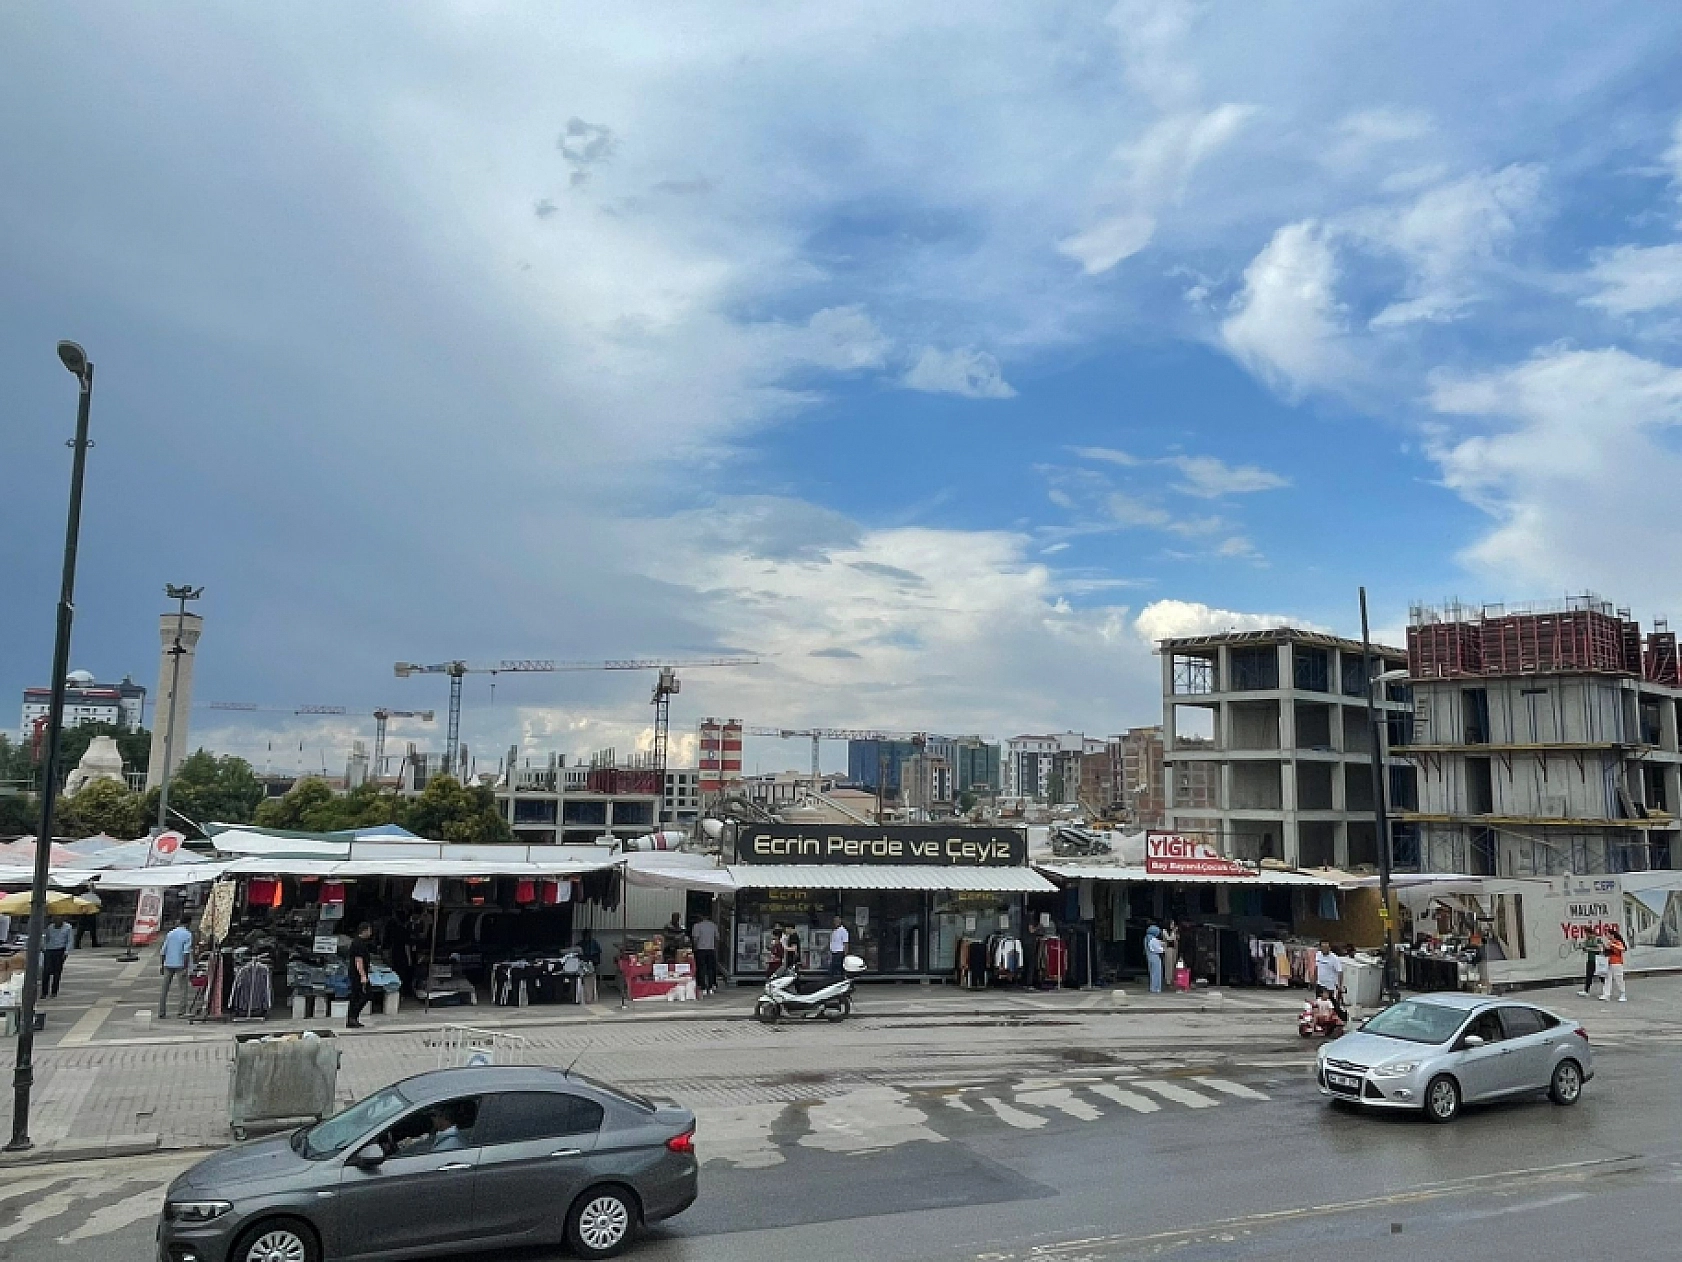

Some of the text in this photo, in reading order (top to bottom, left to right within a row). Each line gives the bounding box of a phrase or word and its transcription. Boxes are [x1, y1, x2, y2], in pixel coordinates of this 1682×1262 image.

[753, 834, 1011, 864] Ecrin Perde ve Çeyiz
